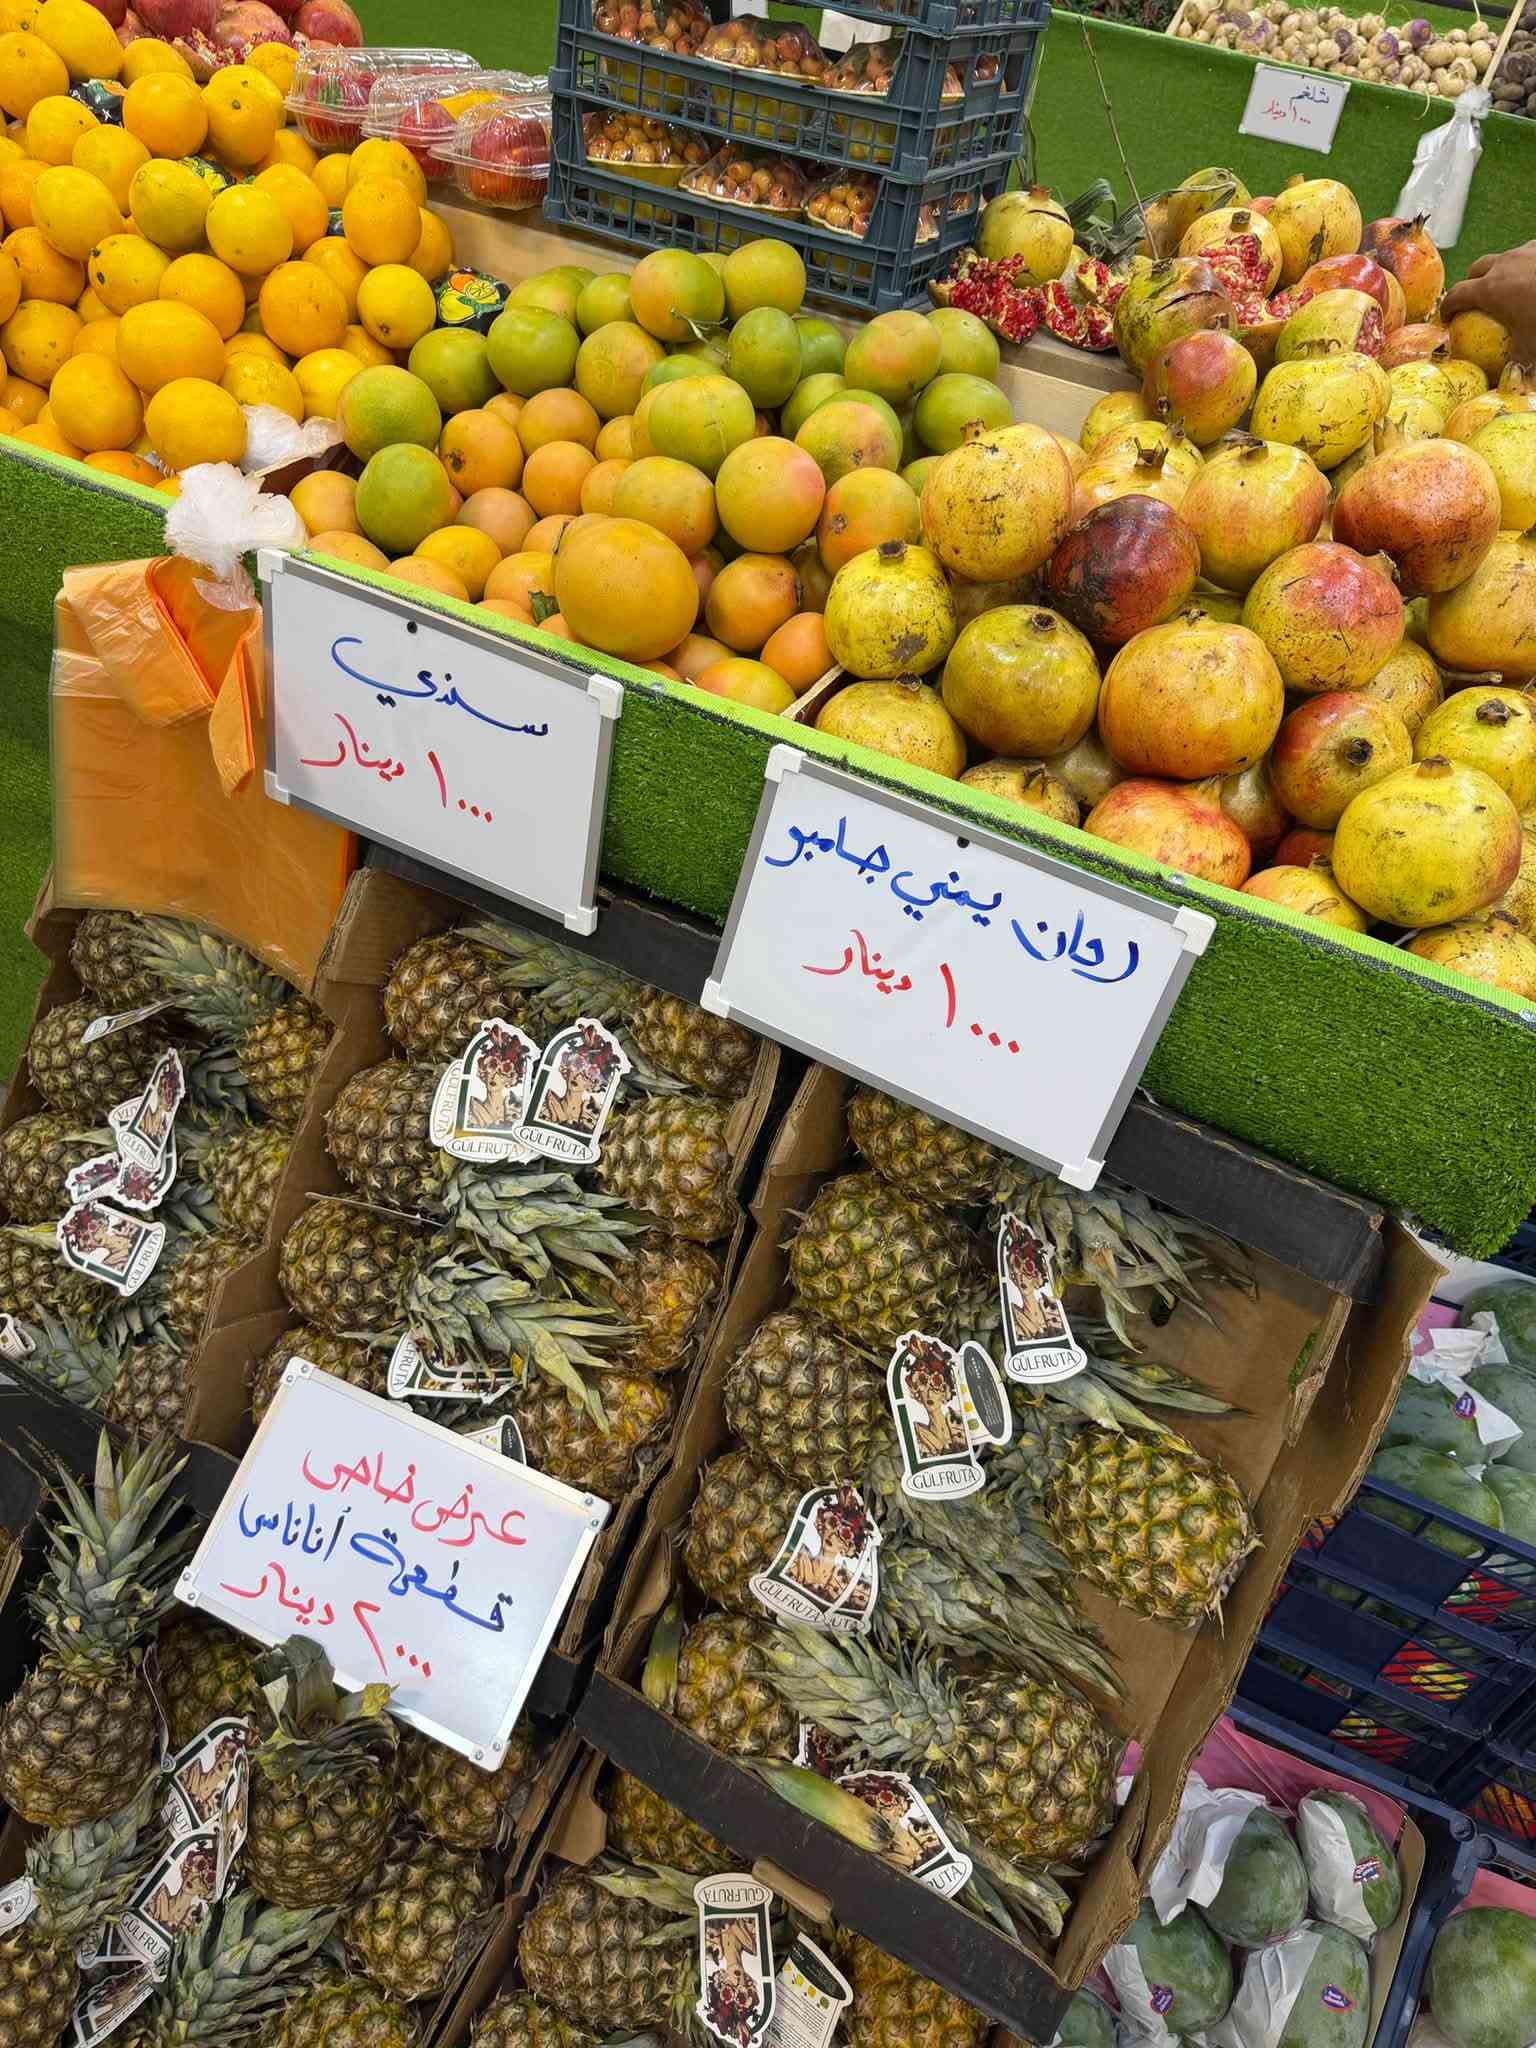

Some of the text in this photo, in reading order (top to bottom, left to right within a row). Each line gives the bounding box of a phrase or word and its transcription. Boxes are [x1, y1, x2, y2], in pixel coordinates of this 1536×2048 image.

[300, 712, 405, 782] دينار
[890, 870, 1002, 926] يمني
[802, 929, 912, 994] دينار
[1011, 909, 1140, 983] رمان
[302, 1449, 527, 1547] عرض خاص
[219, 1561, 336, 1627] دينار
